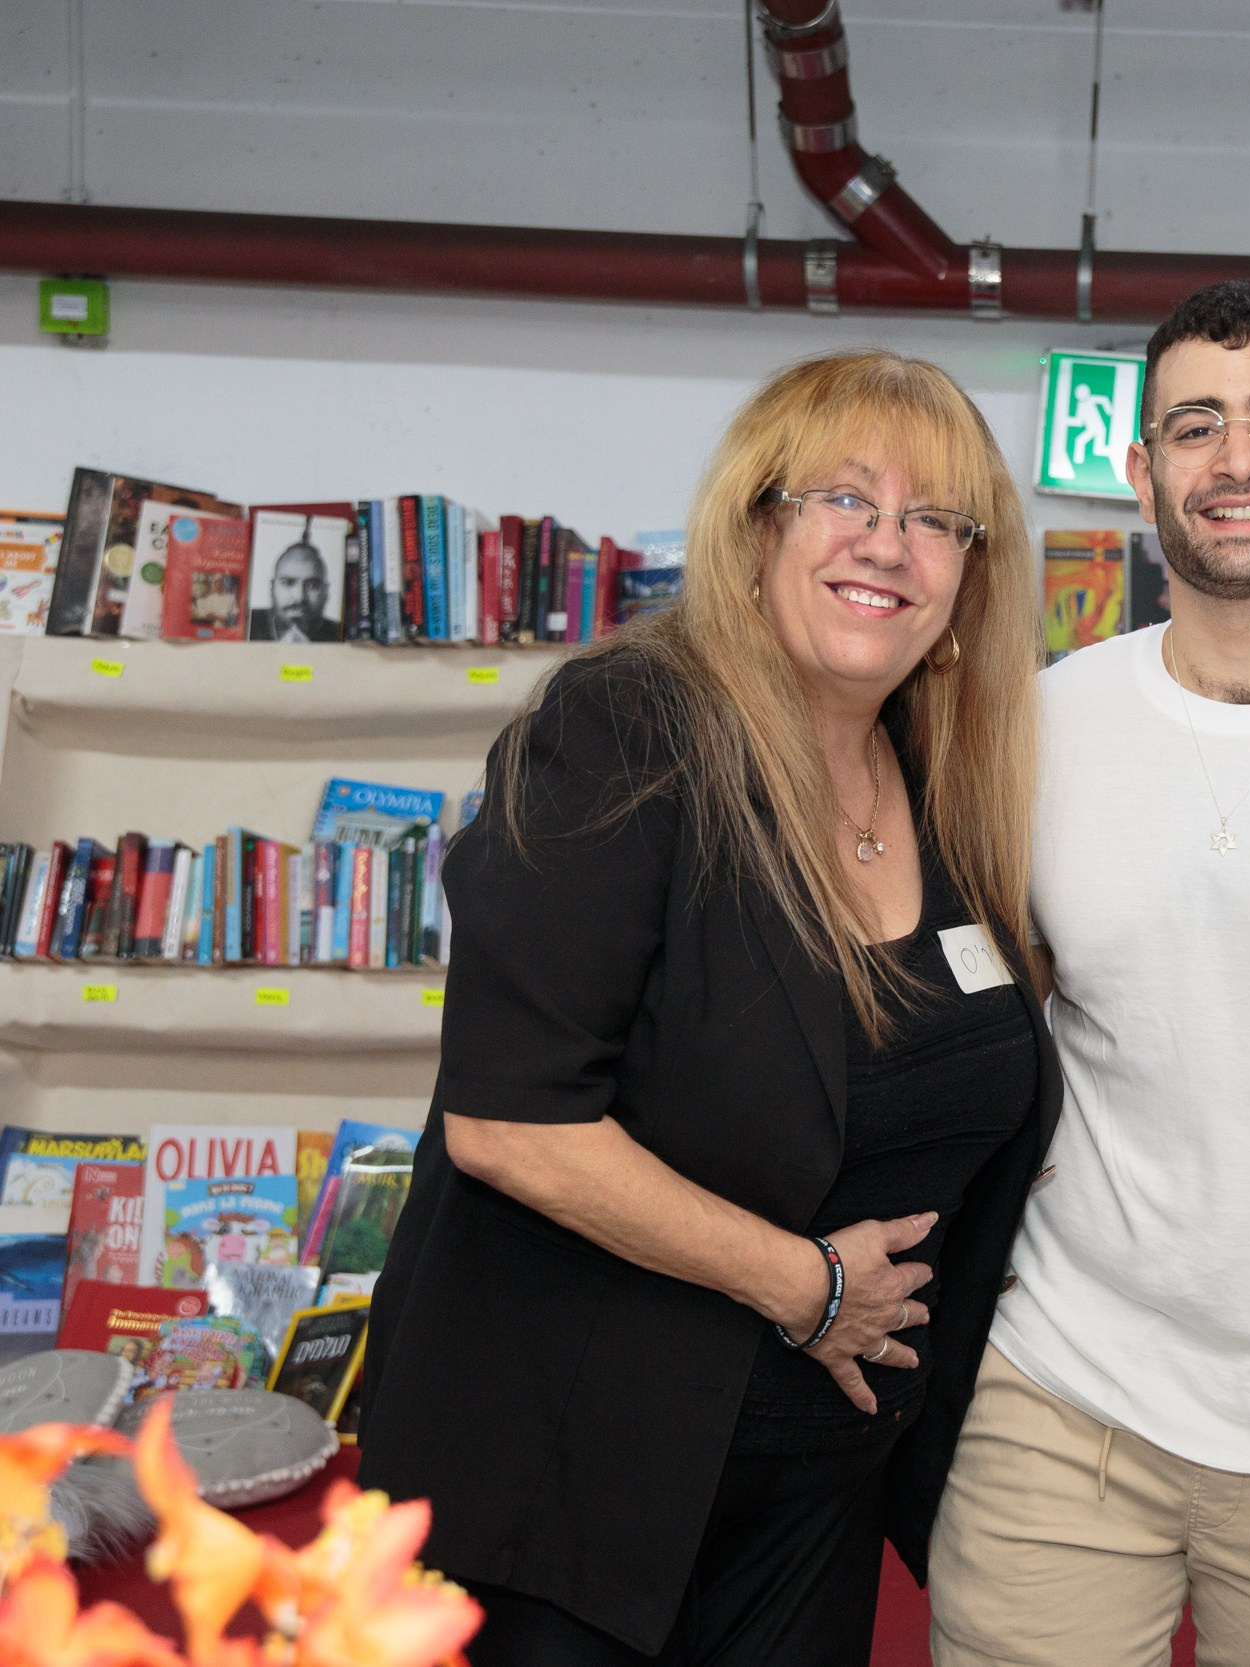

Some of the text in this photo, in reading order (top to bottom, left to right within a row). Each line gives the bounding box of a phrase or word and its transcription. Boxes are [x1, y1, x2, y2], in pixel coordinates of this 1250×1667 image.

[353, 787, 434, 814] OLYMPIA
[155, 1137, 282, 1182] OLIVIA
[1, 1308, 54, 1325] REAMS
